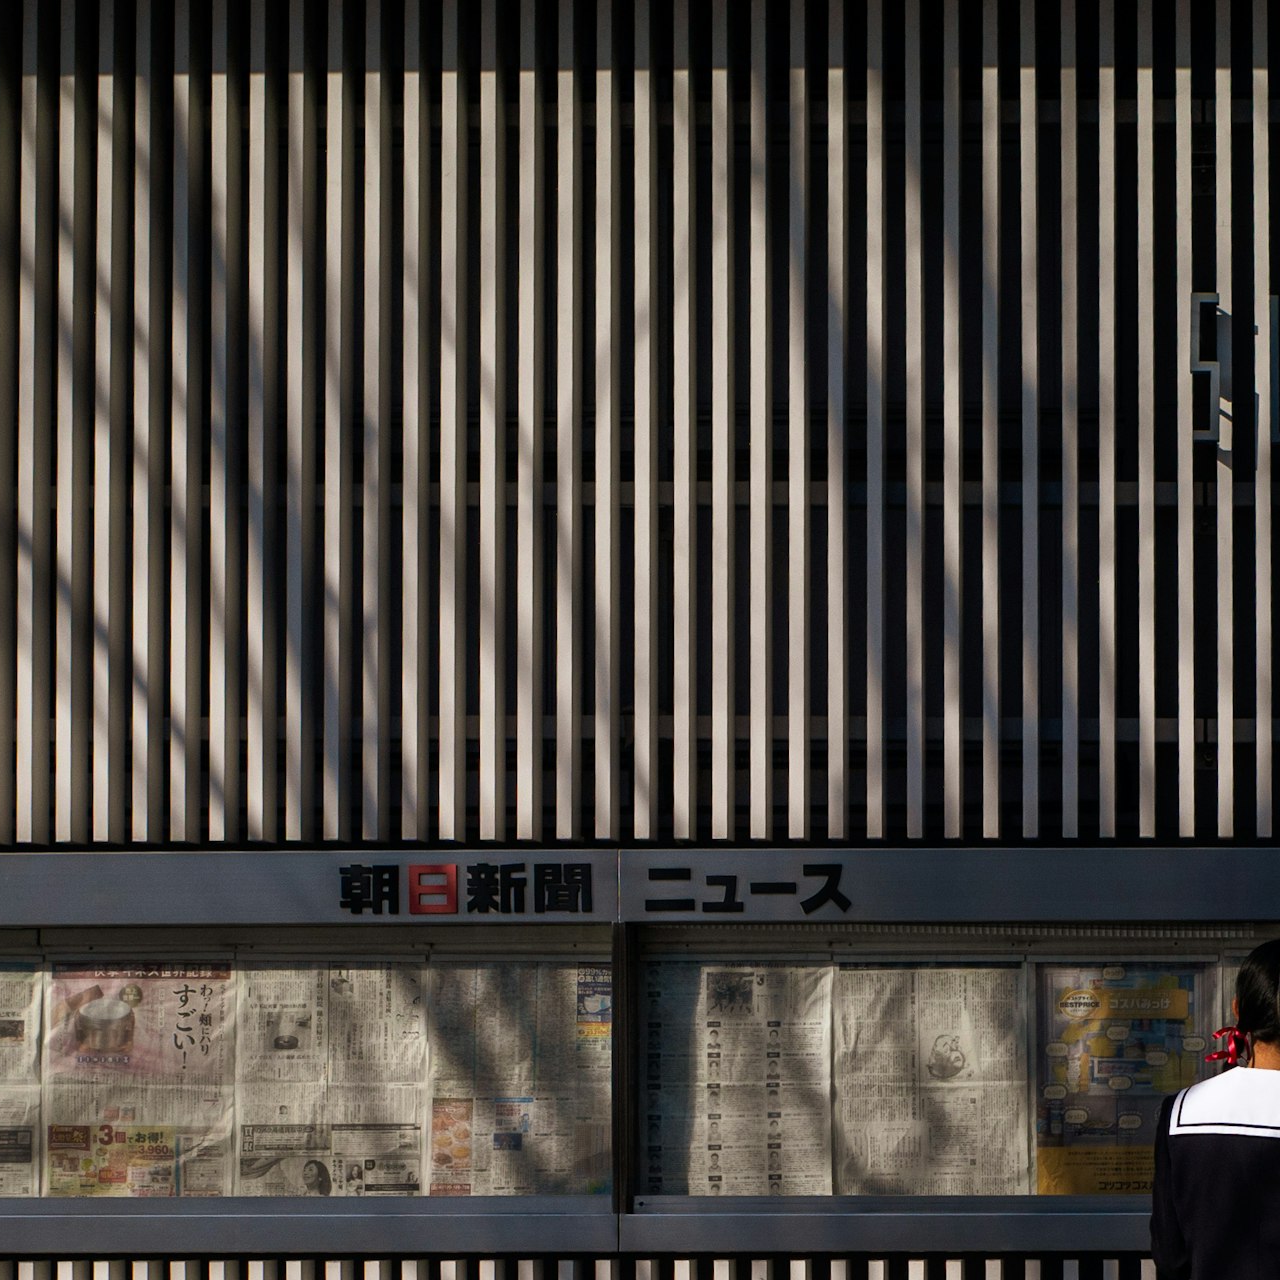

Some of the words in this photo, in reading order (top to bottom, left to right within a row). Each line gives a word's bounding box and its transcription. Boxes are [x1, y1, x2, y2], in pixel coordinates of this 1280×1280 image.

[339, 863, 593, 914] 朝日新聞
[645, 864, 852, 914] ニュース
[173, 984, 197, 1069] すごい!
